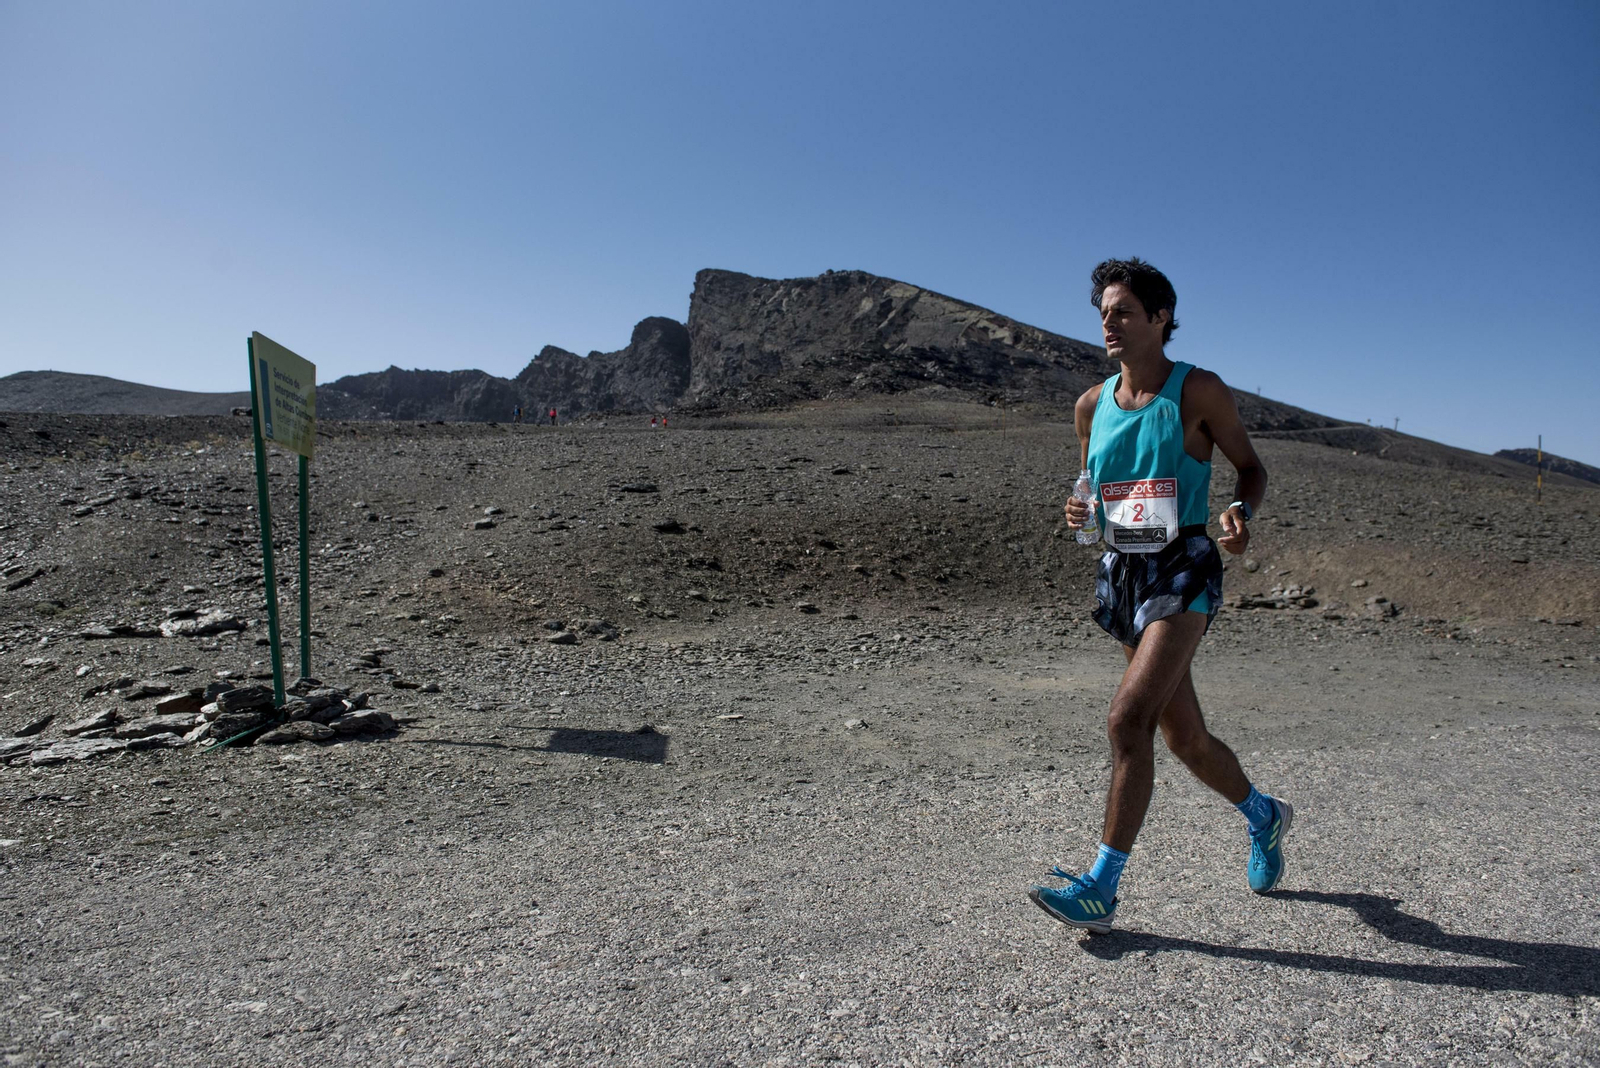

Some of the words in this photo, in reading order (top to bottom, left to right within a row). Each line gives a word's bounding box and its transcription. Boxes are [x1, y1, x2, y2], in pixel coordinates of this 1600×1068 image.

[273, 367, 294, 386] Servicio
[293, 380, 300, 389] de
[275, 397, 281, 408] de
[1104, 480, 1173, 496] alssport.es
[1132, 503, 1144, 522] 2
